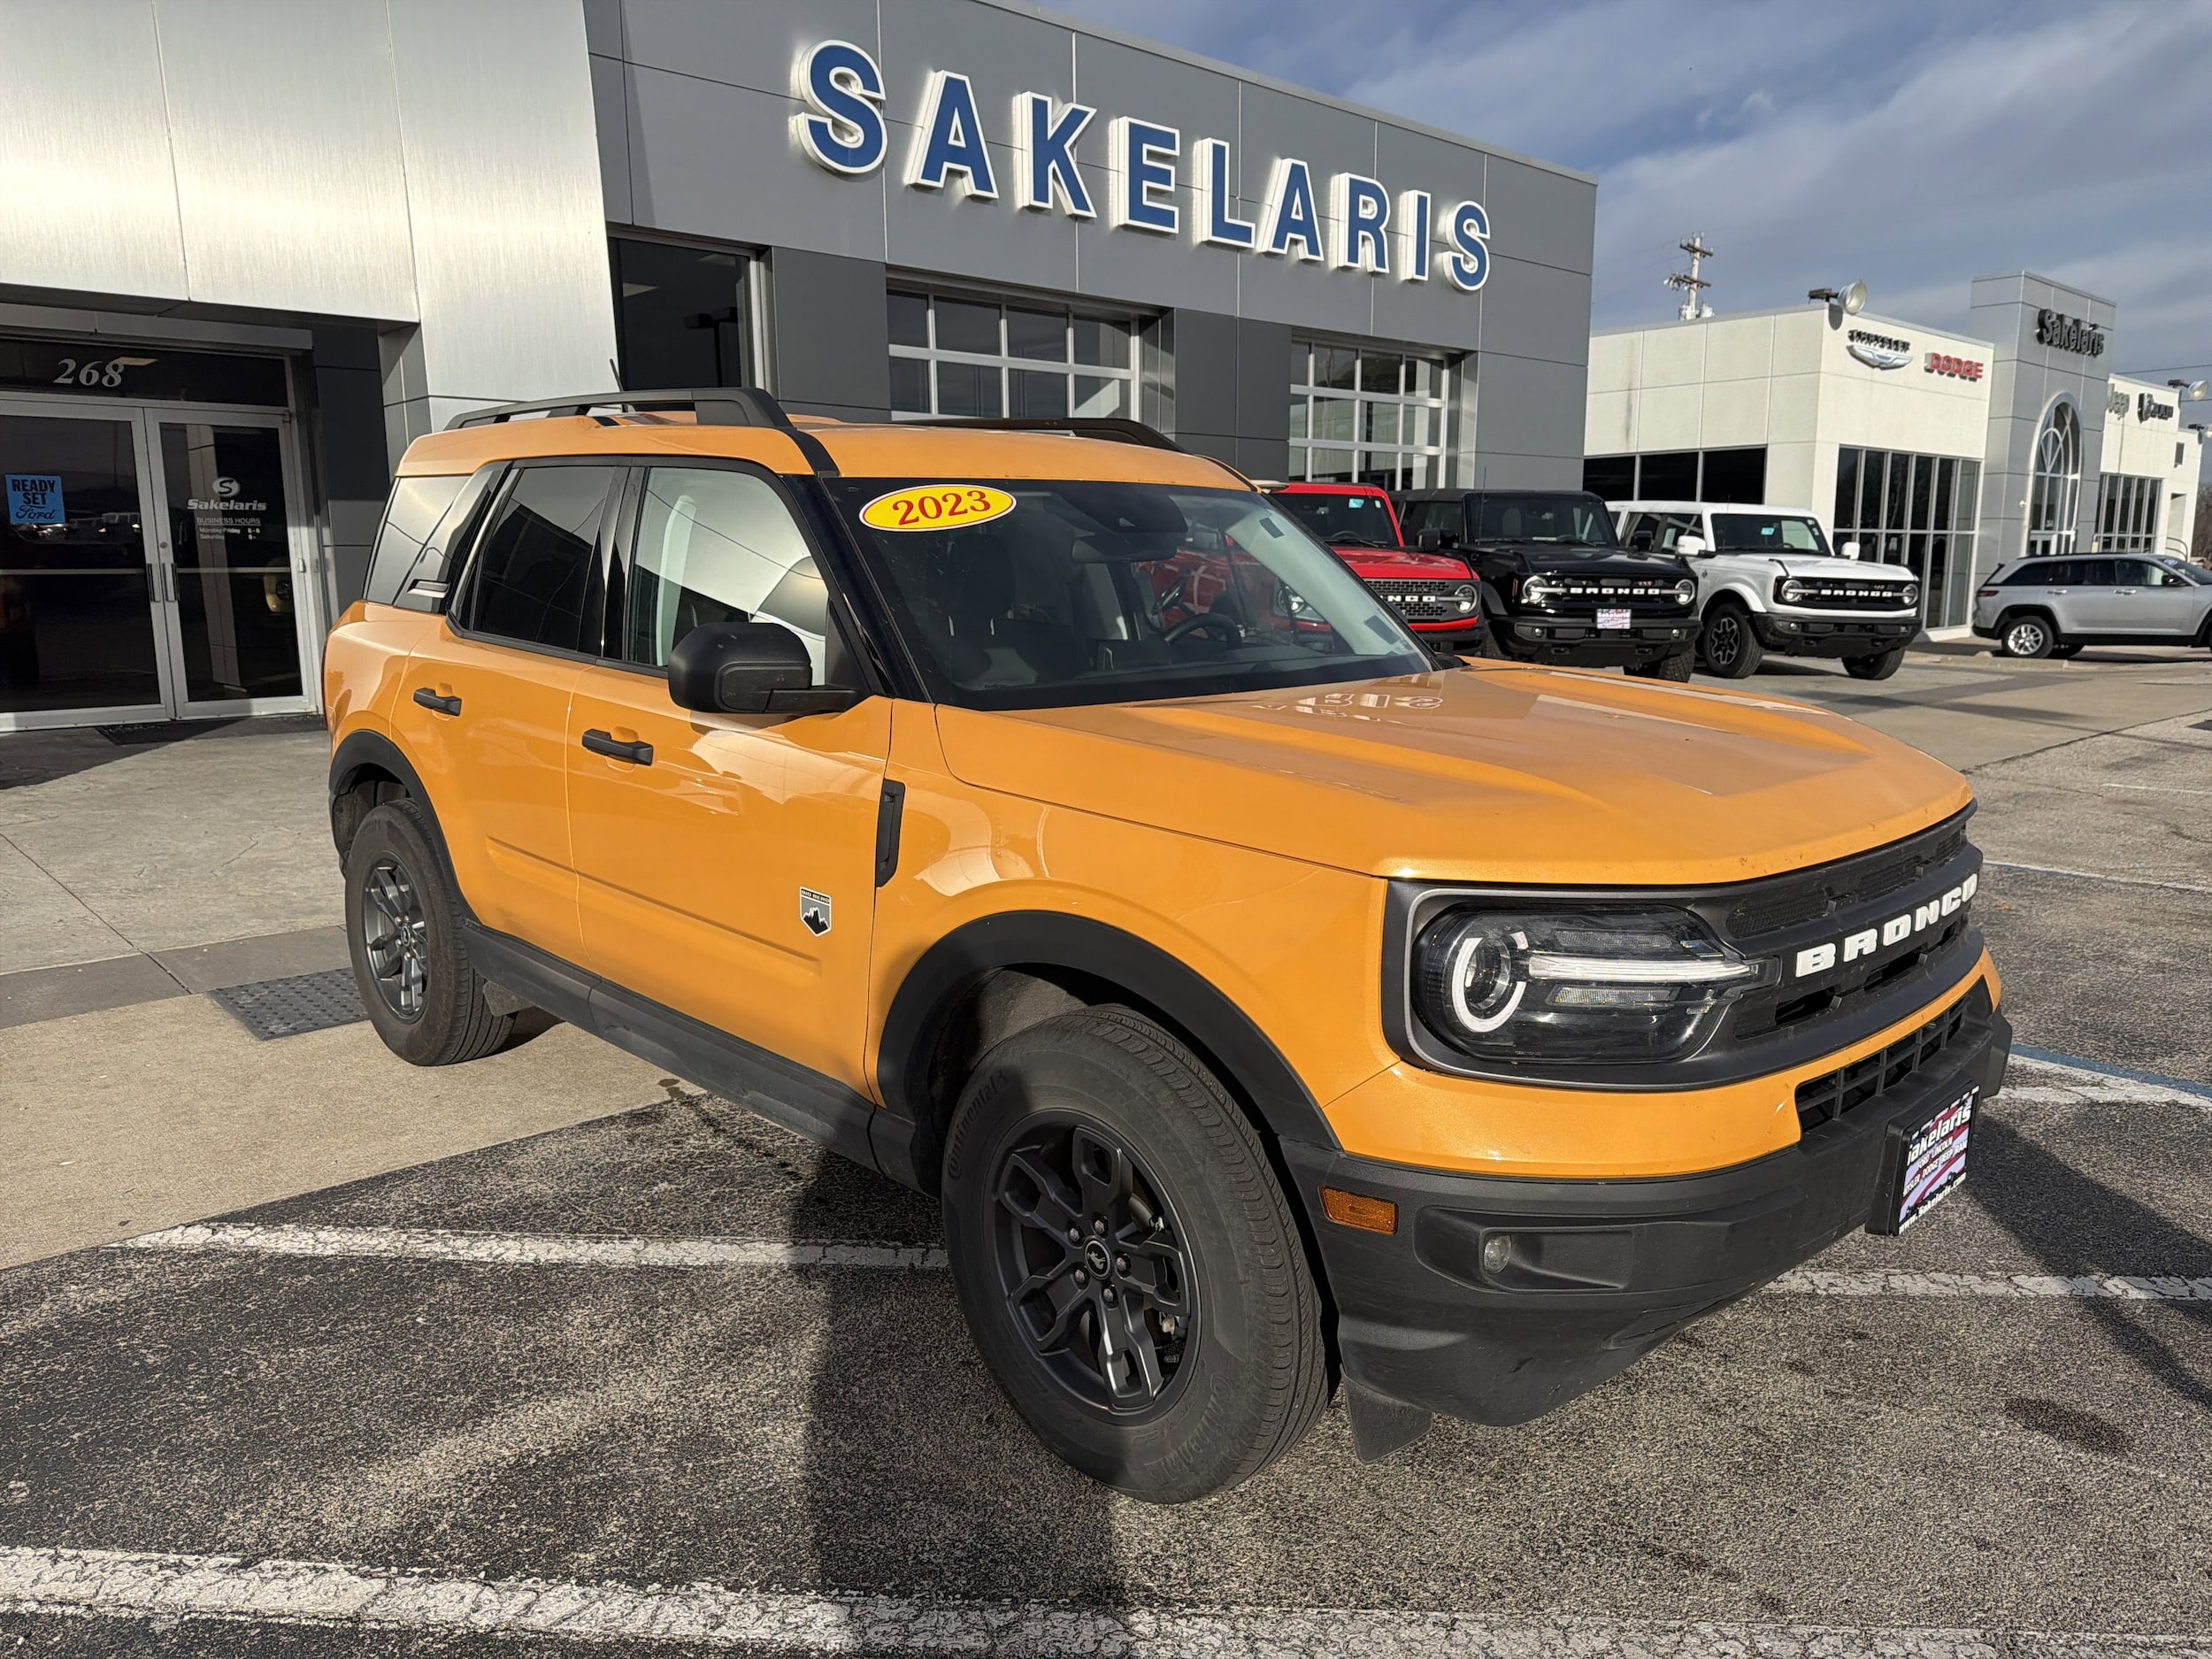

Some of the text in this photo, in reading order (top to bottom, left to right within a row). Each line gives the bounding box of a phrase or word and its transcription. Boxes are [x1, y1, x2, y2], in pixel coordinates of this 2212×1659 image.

[793, 39, 1491, 293] SAKELARIS
[2037, 309, 2105, 357] Sakelaris
[53, 357, 125, 388] 268
[1927, 352, 1984, 380] DODGE
[12, 479, 57, 492] READY
[23, 492, 48, 505] SET
[16, 504, 57, 520] Ford
[187, 498, 267, 511] Sakelaris
[892, 490, 991, 526] 2023
[1570, 587, 1661, 595] BRONCO
[1795, 873, 1978, 978] BRONCO
